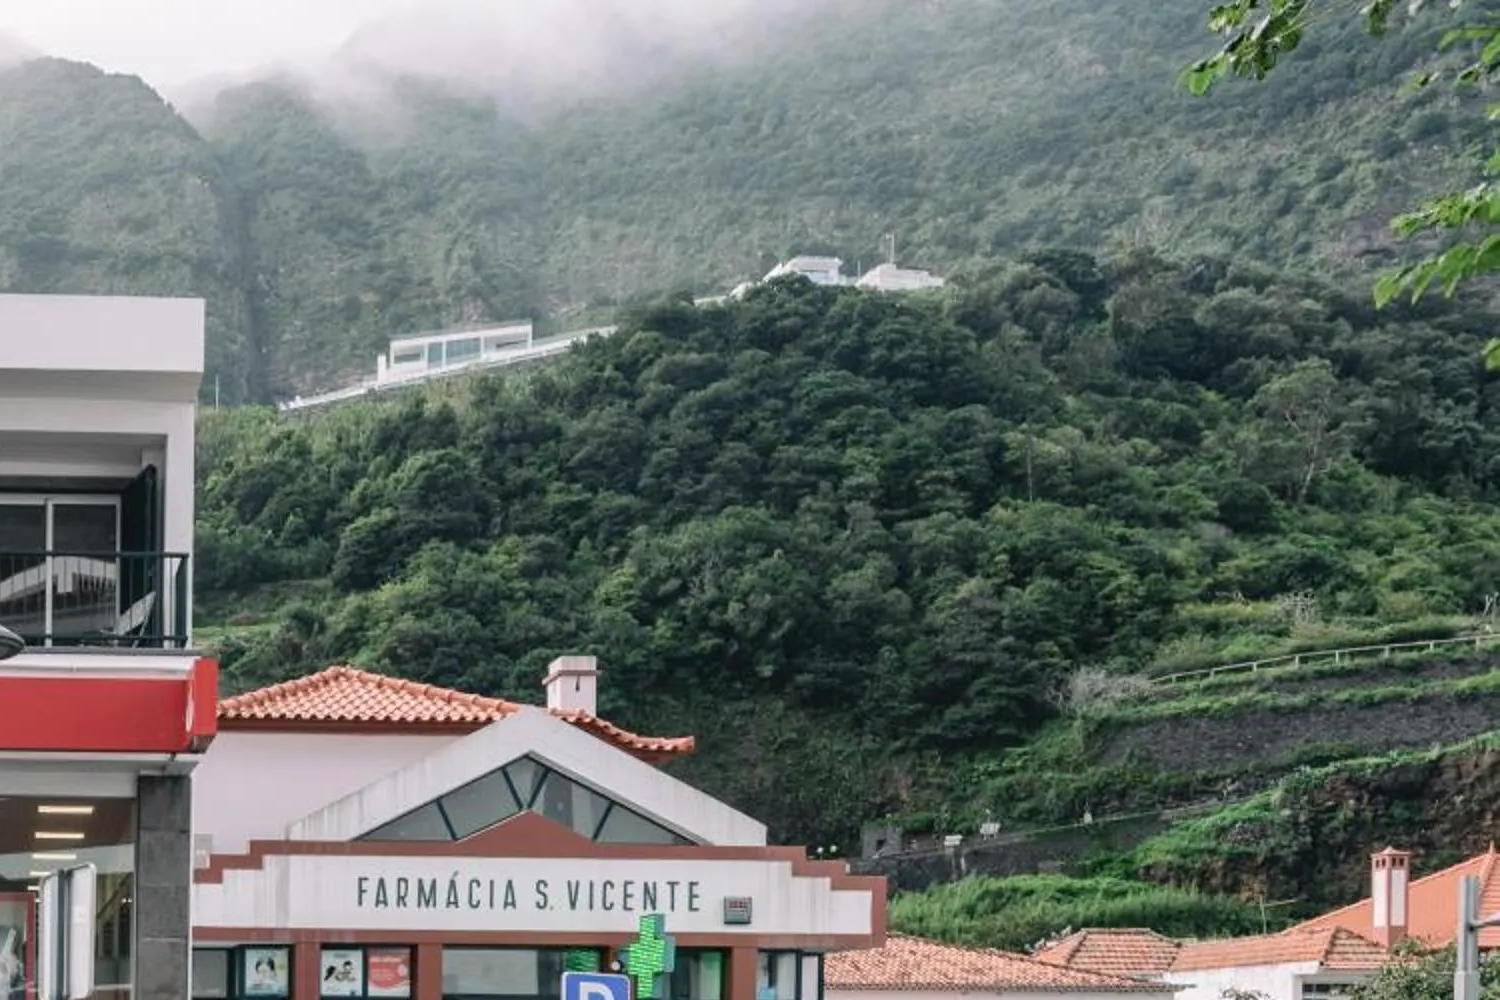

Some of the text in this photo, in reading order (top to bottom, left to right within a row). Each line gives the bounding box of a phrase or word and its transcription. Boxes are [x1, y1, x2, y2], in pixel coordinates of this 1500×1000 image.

[357, 870, 701, 912] FARMÁCIA S. VICENTE
